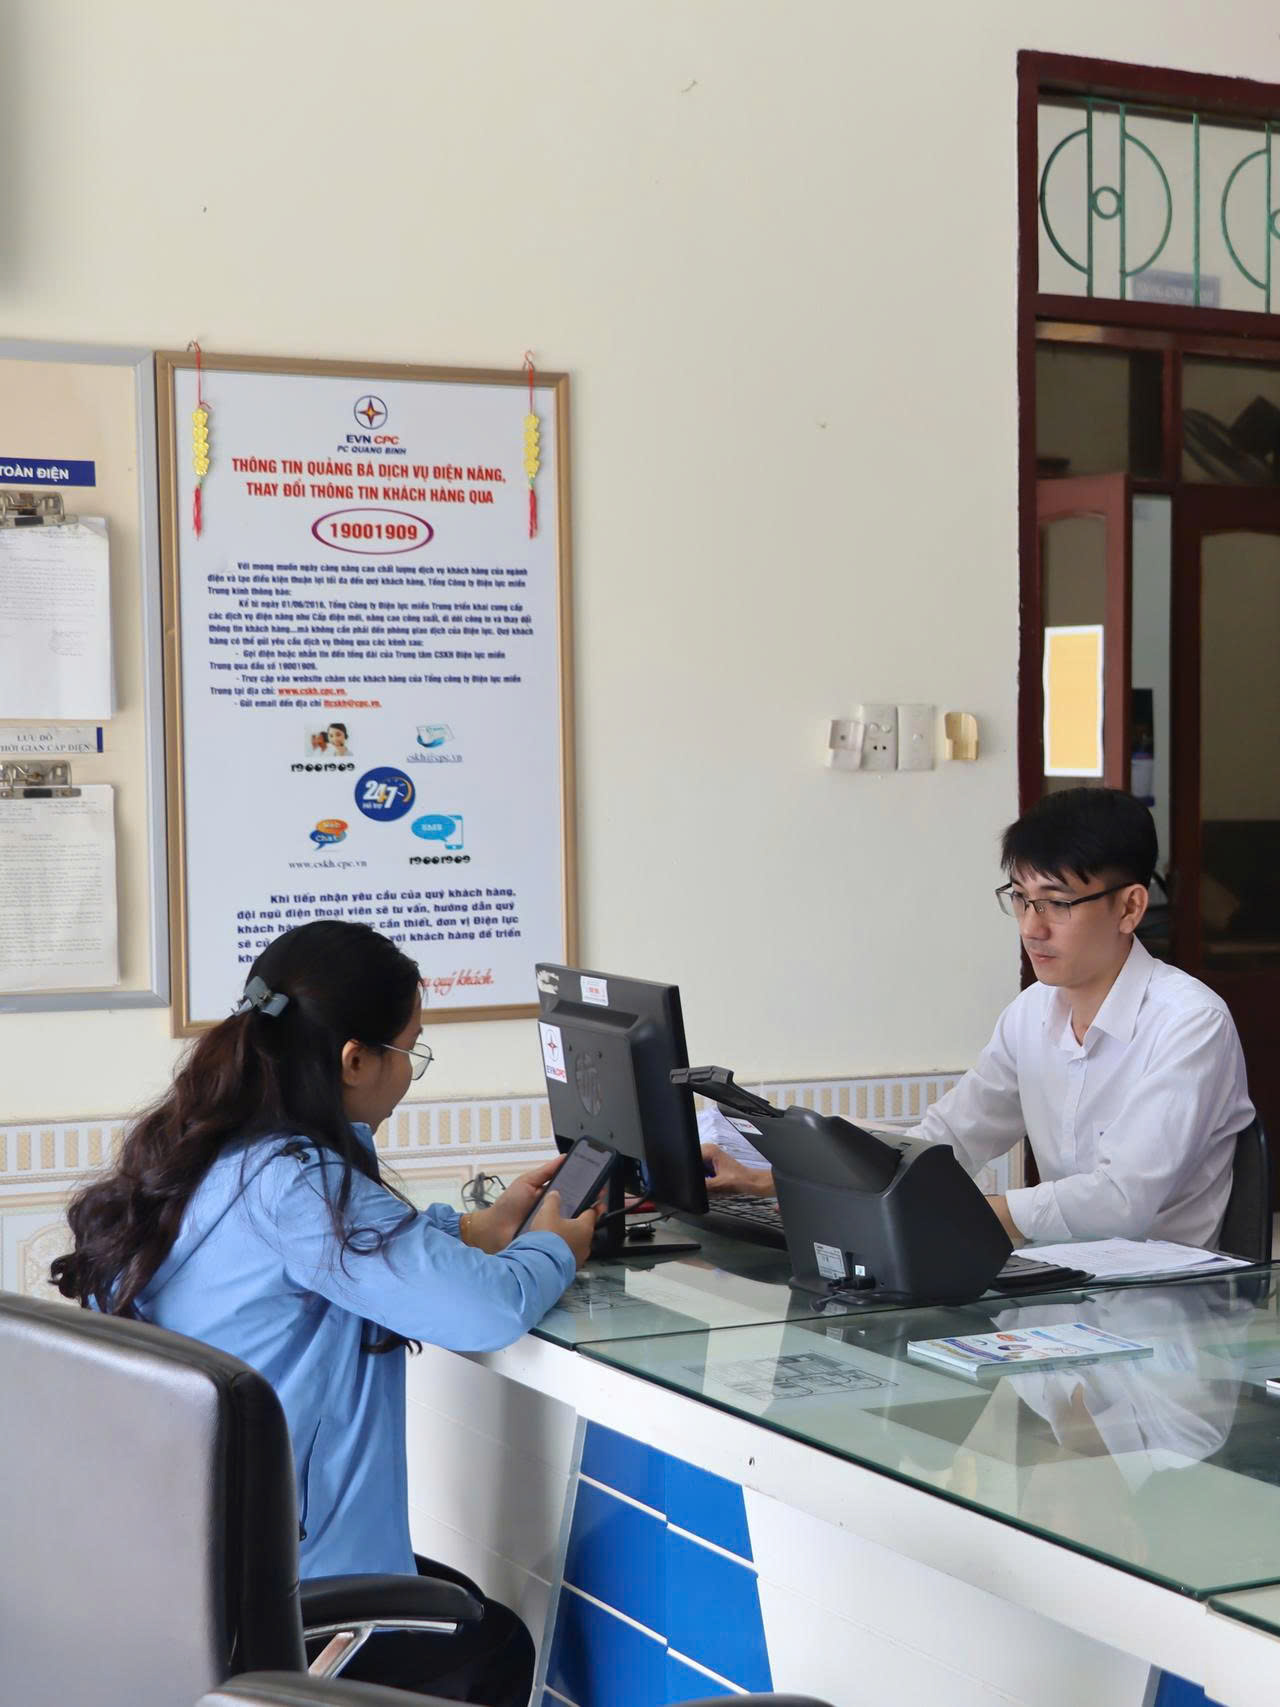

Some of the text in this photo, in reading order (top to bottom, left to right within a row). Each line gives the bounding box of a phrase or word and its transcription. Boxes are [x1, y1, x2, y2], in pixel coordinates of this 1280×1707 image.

[346, 435, 398, 444] EVN CPC
[36, 466, 69, 482] ĐIỆN
[232, 456, 277, 473] THÔNG
[281, 460, 303, 474] TIN
[307, 457, 352, 476] QUẢNG
[378, 464, 409, 481] DỊCH
[413, 465, 429, 482] VỤ
[433, 464, 463, 483] ĐIỆN
[247, 479, 494, 504] THAY ĐỔI THÔNG TIN KHÁCH HÀNG QUA
[330, 523, 417, 540] 19001909
[271, 895, 289, 903] Khi
[448, 889, 482, 897] khách
[237, 923, 274, 934] khách
[256, 937, 270, 947] cù
[410, 931, 444, 941] khách
